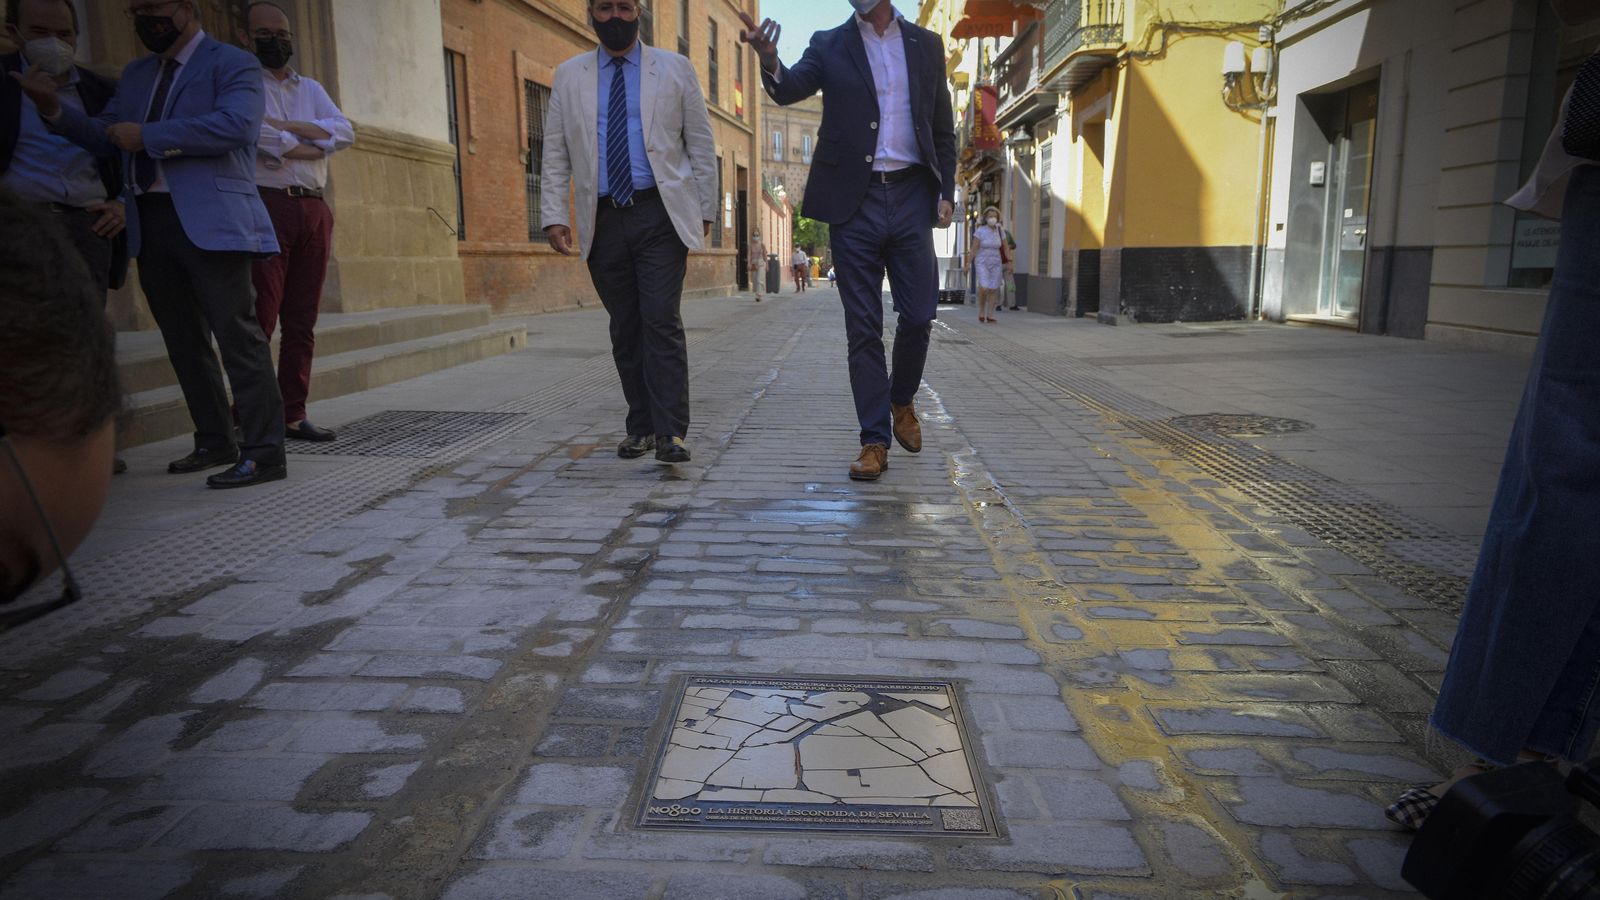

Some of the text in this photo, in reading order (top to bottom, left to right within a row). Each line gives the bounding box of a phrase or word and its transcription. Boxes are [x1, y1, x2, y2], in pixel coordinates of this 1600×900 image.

[708, 807, 724, 815] LA
[727, 807, 784, 816] HISTORIA
[786, 809, 857, 817] ESCONDIDA
[878, 811, 930, 819] SEVILLA
